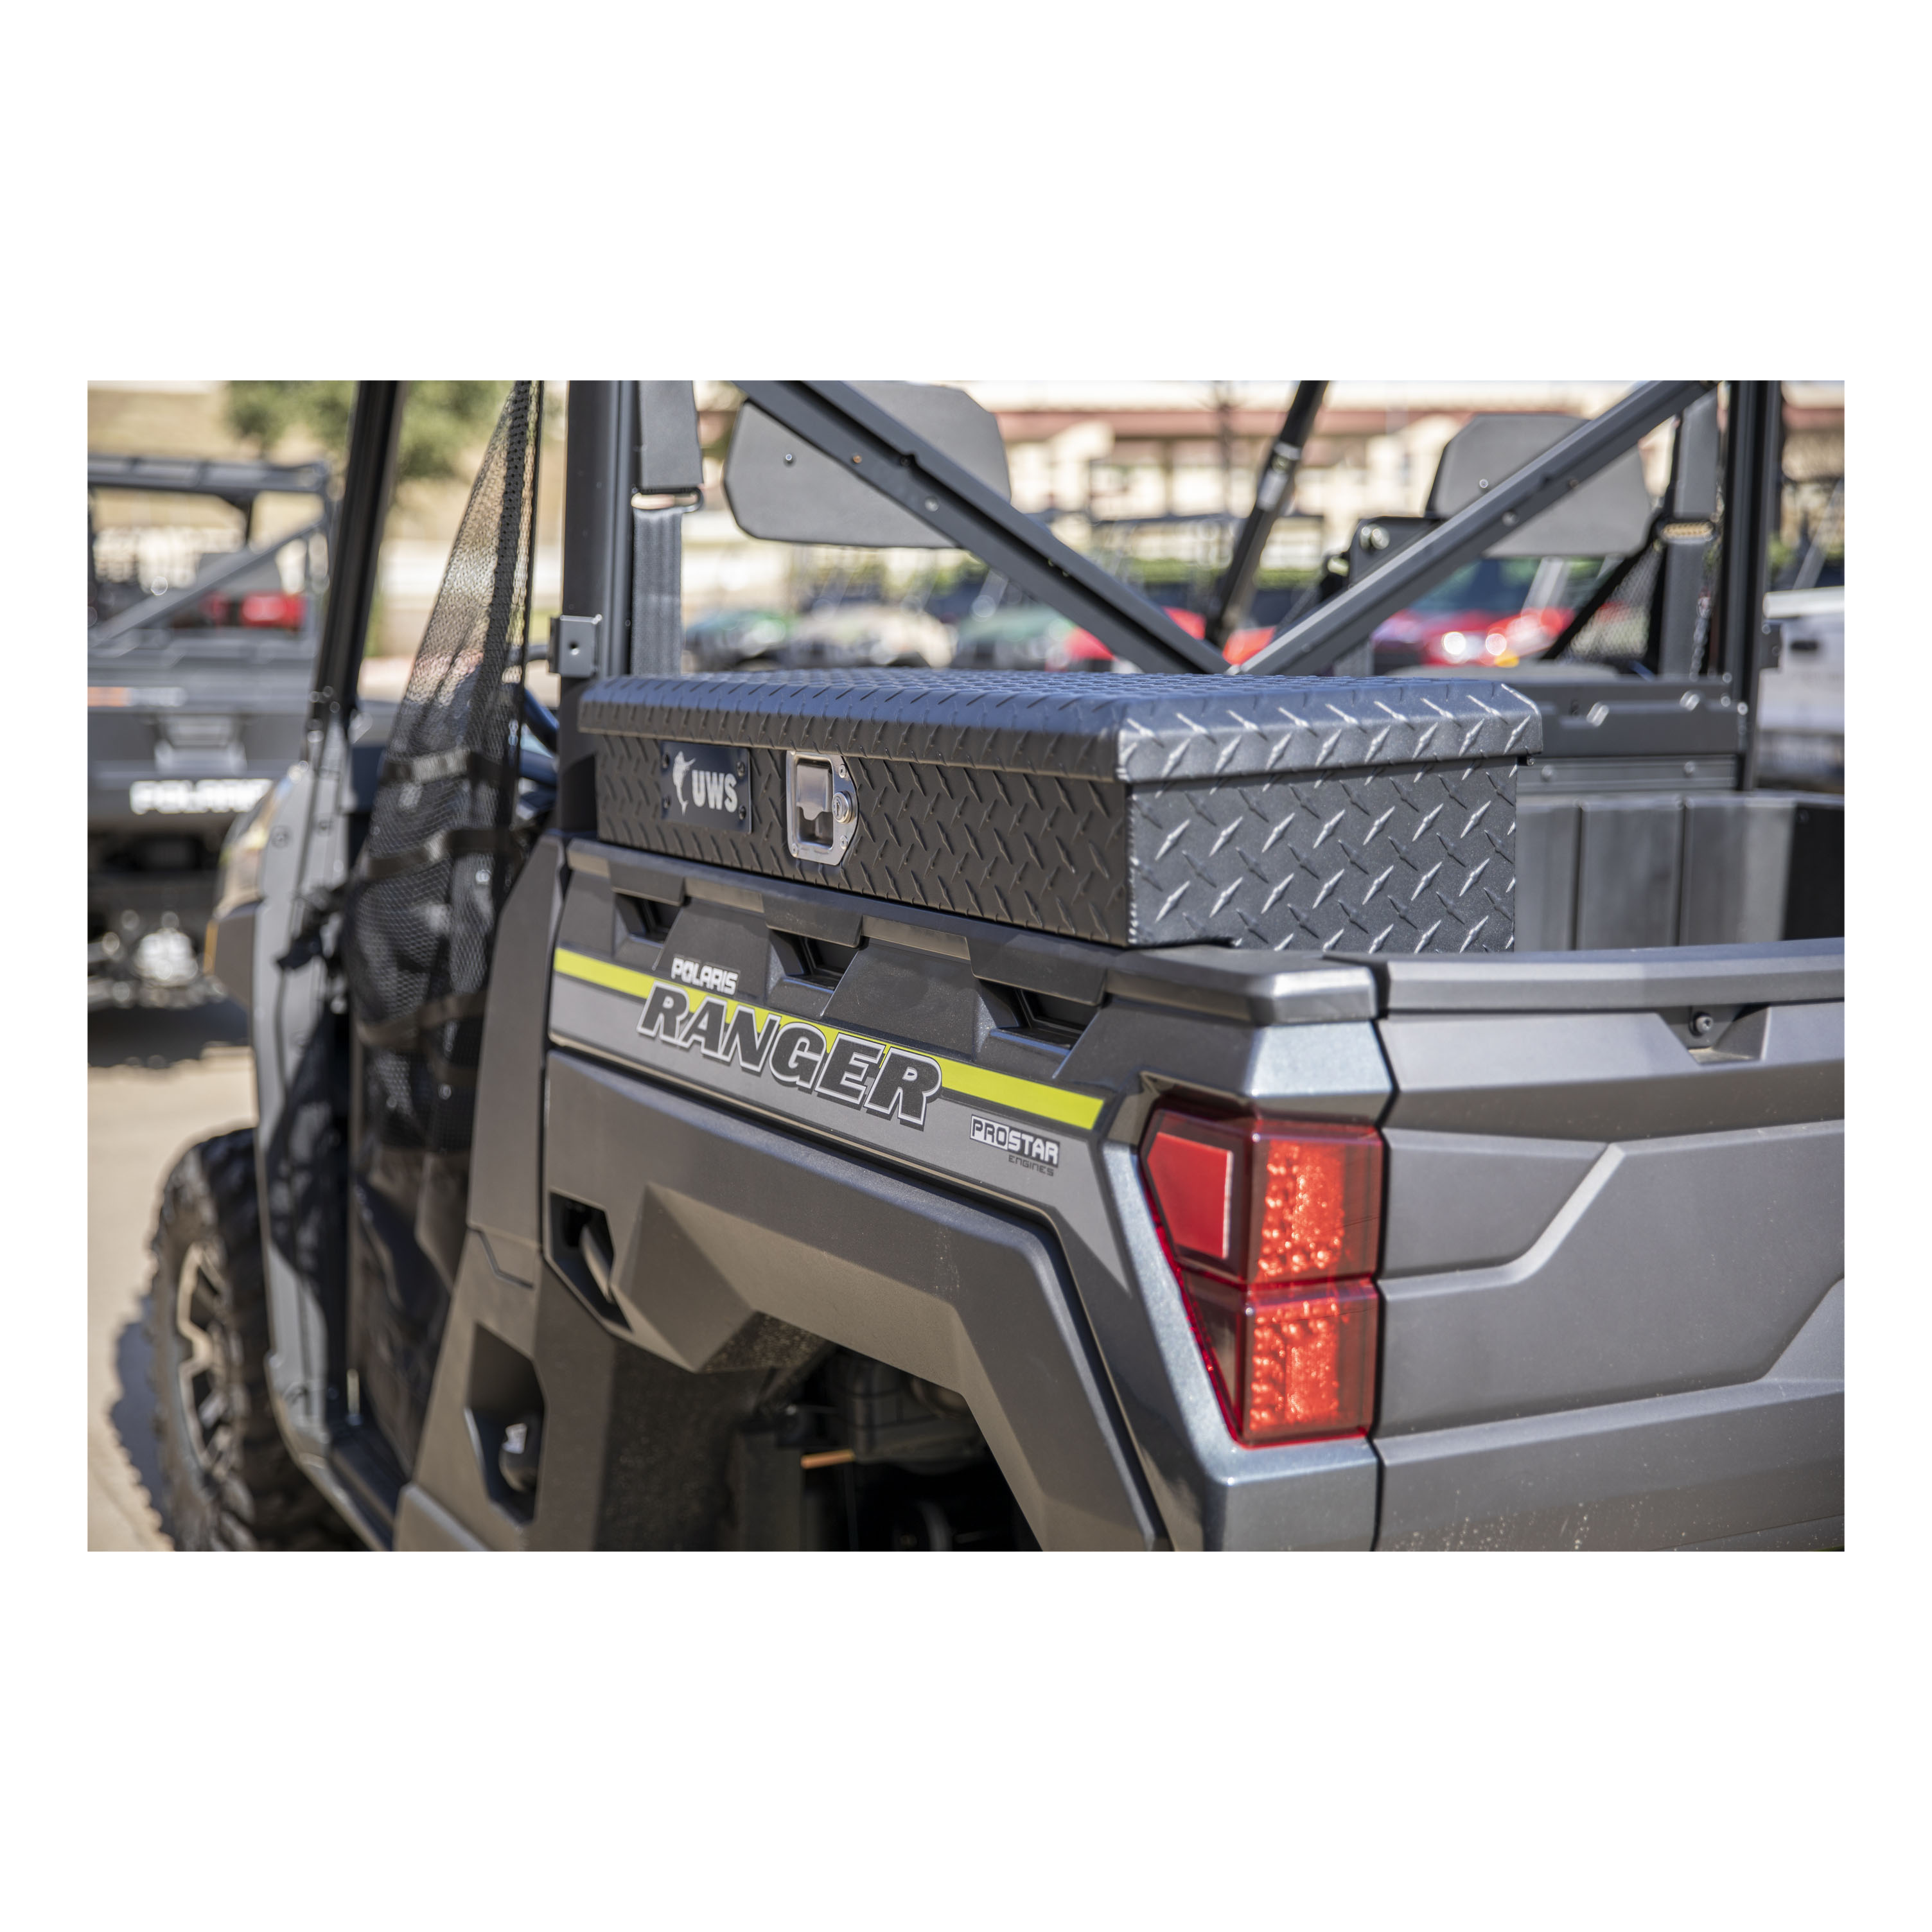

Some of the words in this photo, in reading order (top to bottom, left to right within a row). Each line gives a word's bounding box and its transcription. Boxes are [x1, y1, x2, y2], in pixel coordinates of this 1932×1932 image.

[691, 770, 738, 812] UWS
[671, 957, 739, 995] POLARIS
[636, 981, 943, 1127] RANGER
[971, 1115, 1059, 1166] PROSTAR
[1008, 1155, 1054, 1177] ENGINES
